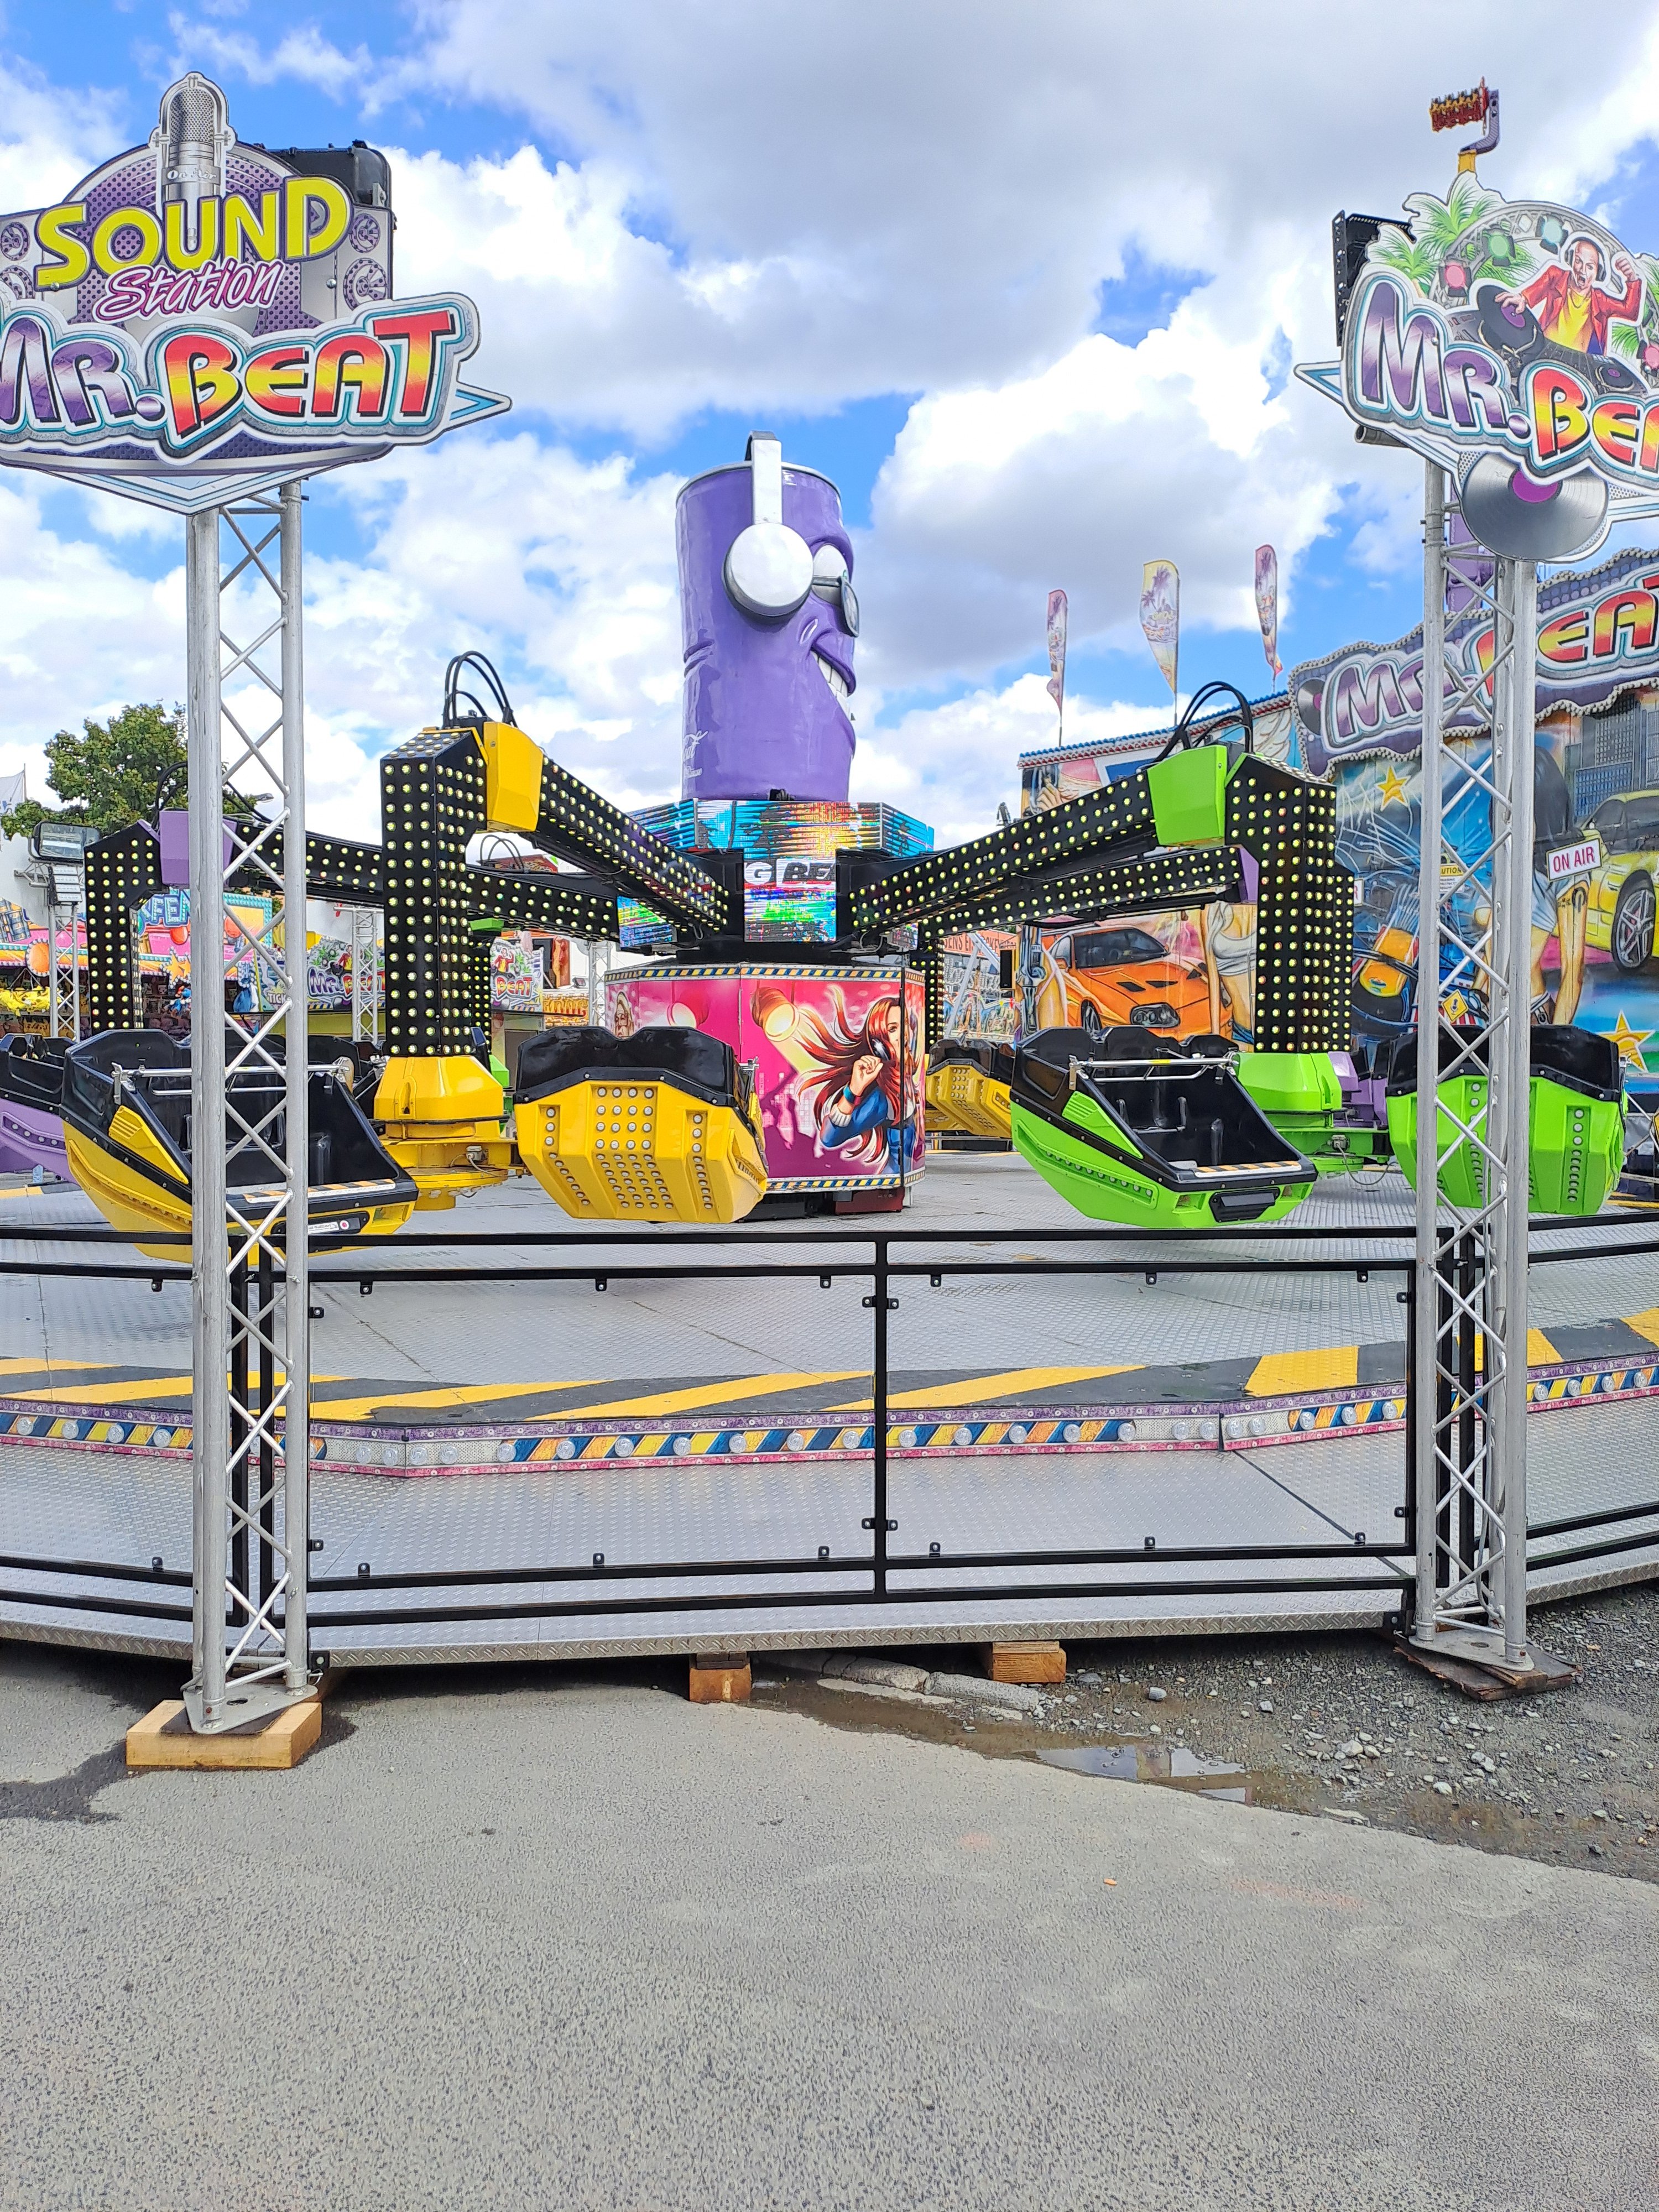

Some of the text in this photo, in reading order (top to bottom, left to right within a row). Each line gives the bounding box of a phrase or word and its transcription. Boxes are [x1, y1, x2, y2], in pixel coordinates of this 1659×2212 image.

[166, 168, 217, 180] On Air
[35, 177, 349, 289] SOUND
[96, 258, 284, 321] Station
[164, 309, 456, 439] BEAT
[1362, 283, 1530, 438] MR.
[1553, 846, 1595, 873] ON AIR
[496, 977, 533, 996] BEAT
